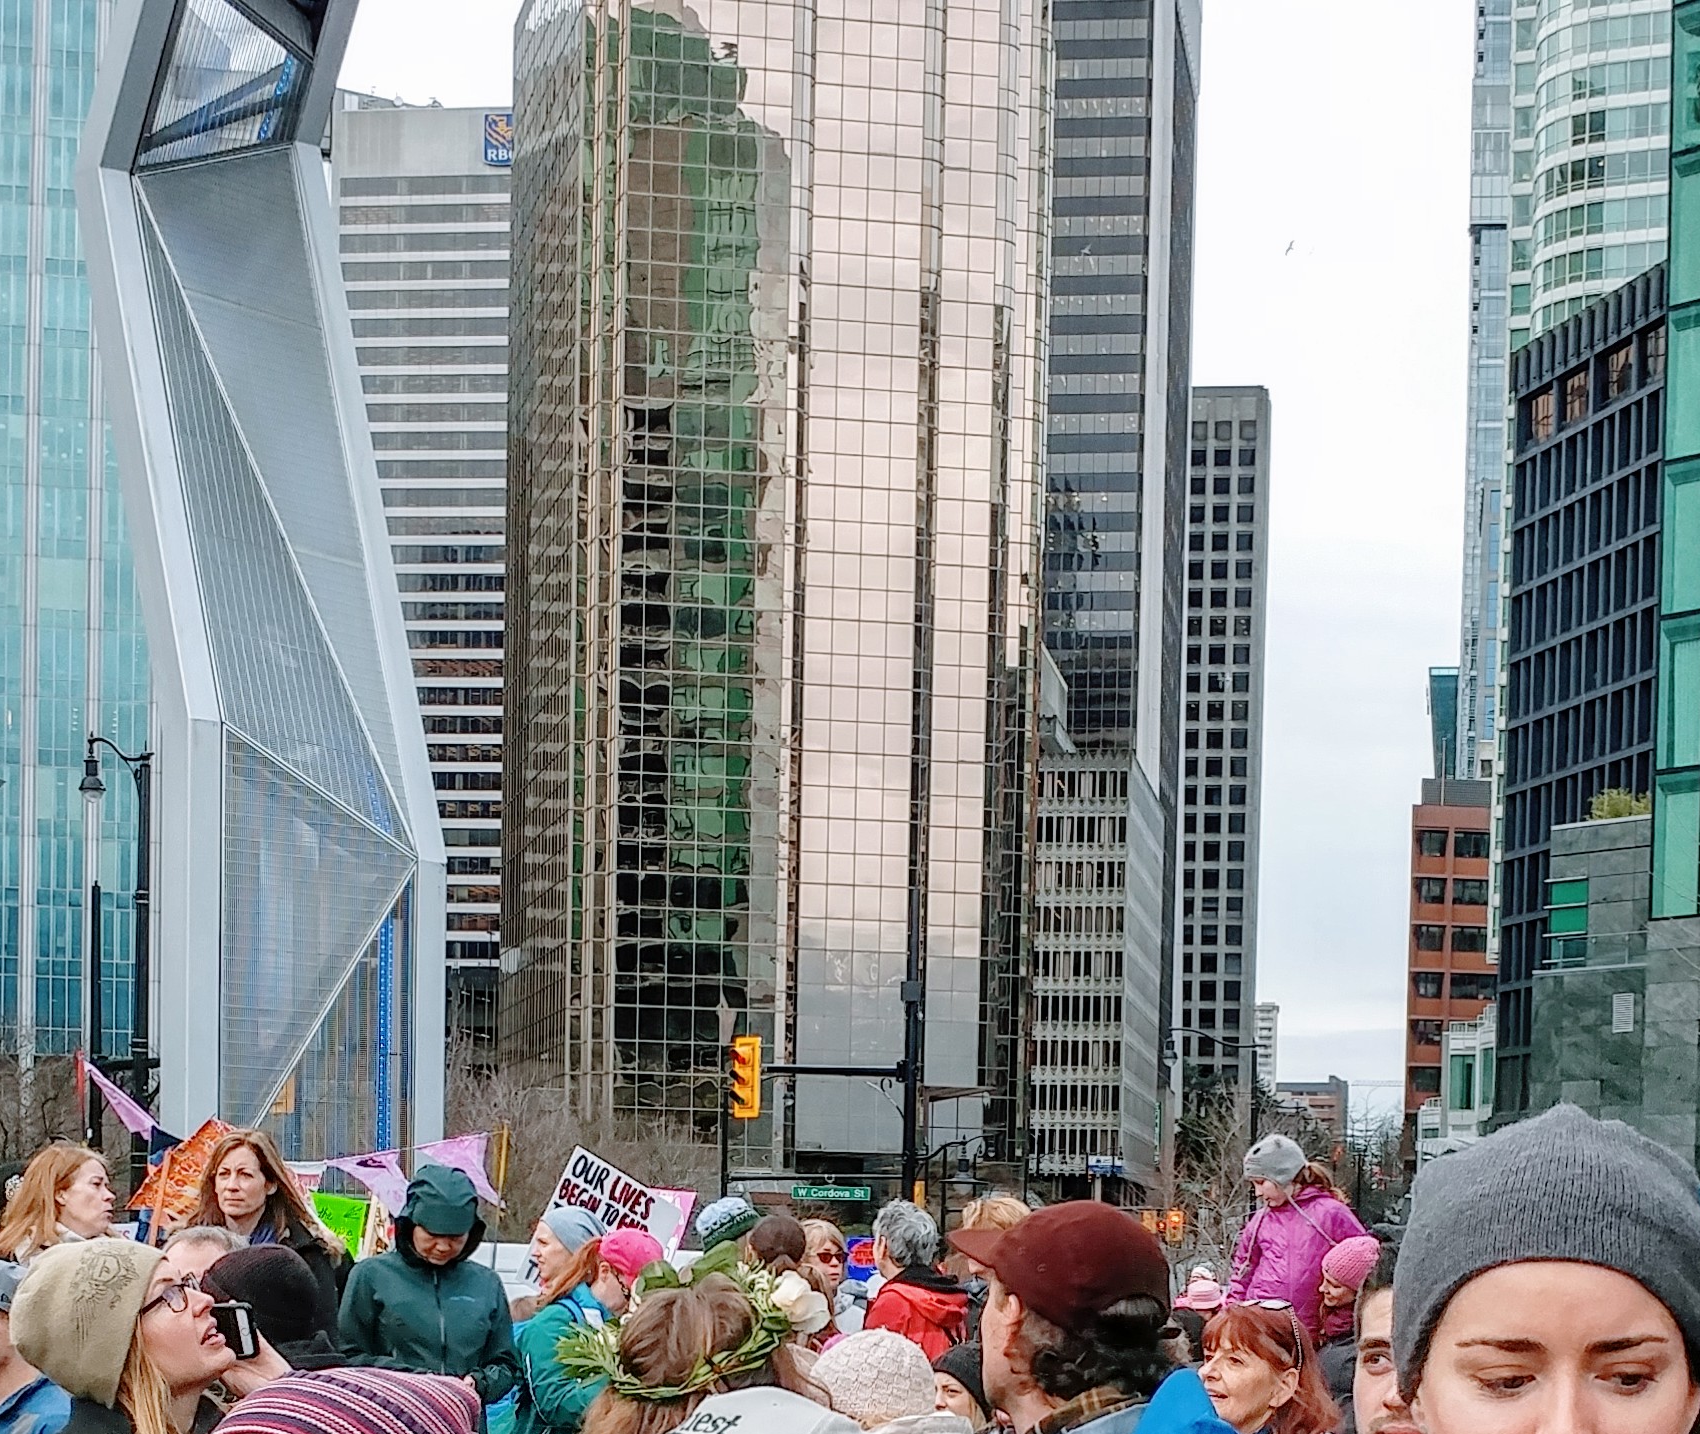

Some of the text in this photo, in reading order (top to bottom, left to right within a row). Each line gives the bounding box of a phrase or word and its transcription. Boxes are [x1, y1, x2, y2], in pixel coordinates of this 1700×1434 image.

[558, 1178, 602, 1214] BEGIN
[601, 1202, 620, 1227] TO
[572, 1154, 656, 1220] OUR LIVES
[797, 1188, 865, 1198] W Cordova St
